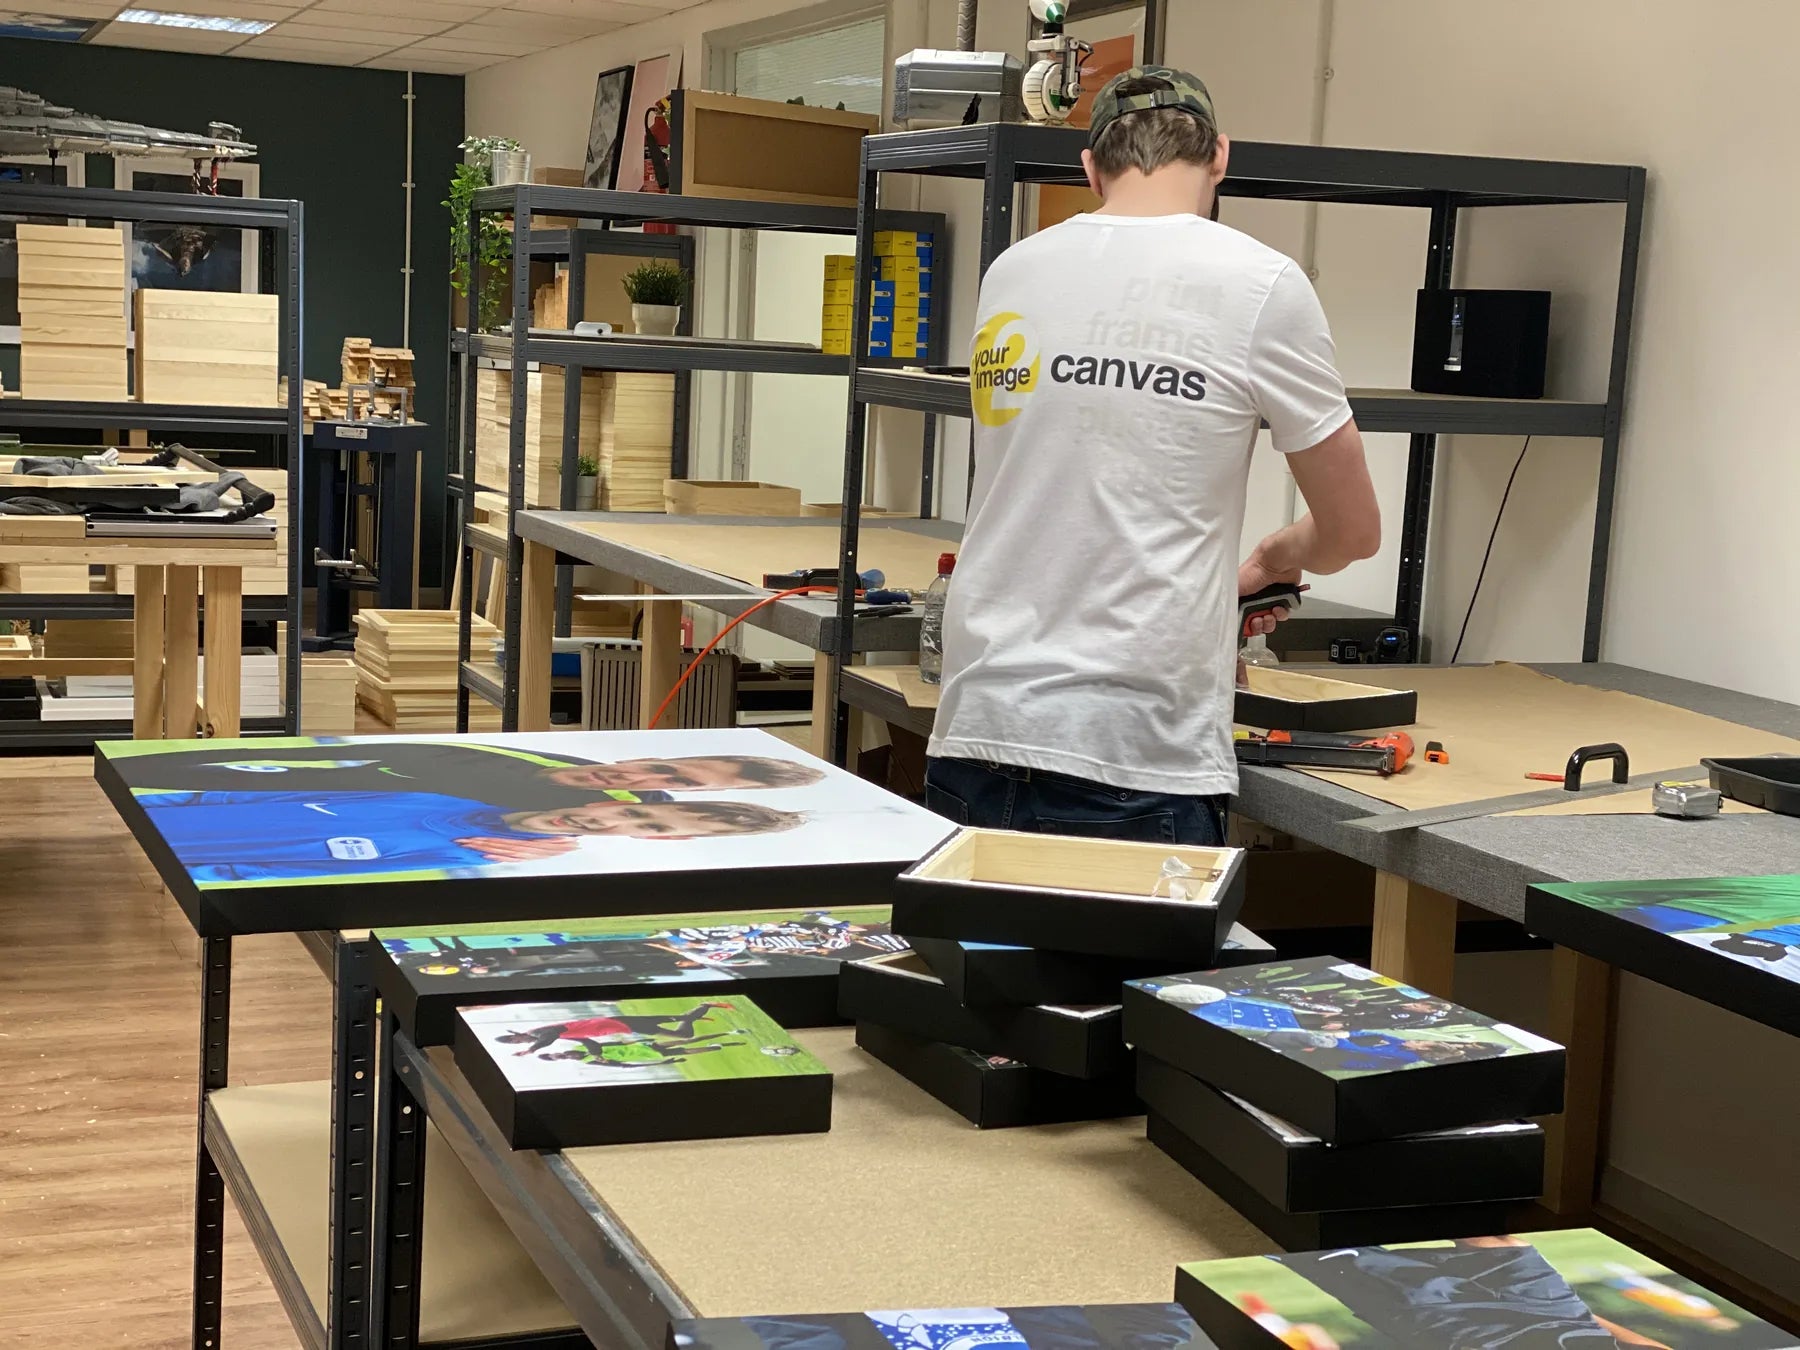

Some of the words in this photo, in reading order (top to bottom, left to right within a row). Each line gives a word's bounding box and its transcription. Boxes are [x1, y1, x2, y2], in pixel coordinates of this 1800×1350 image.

[974, 346, 1010, 375] your
[976, 366, 1031, 392] image
[1050, 353, 1207, 402] canvas
